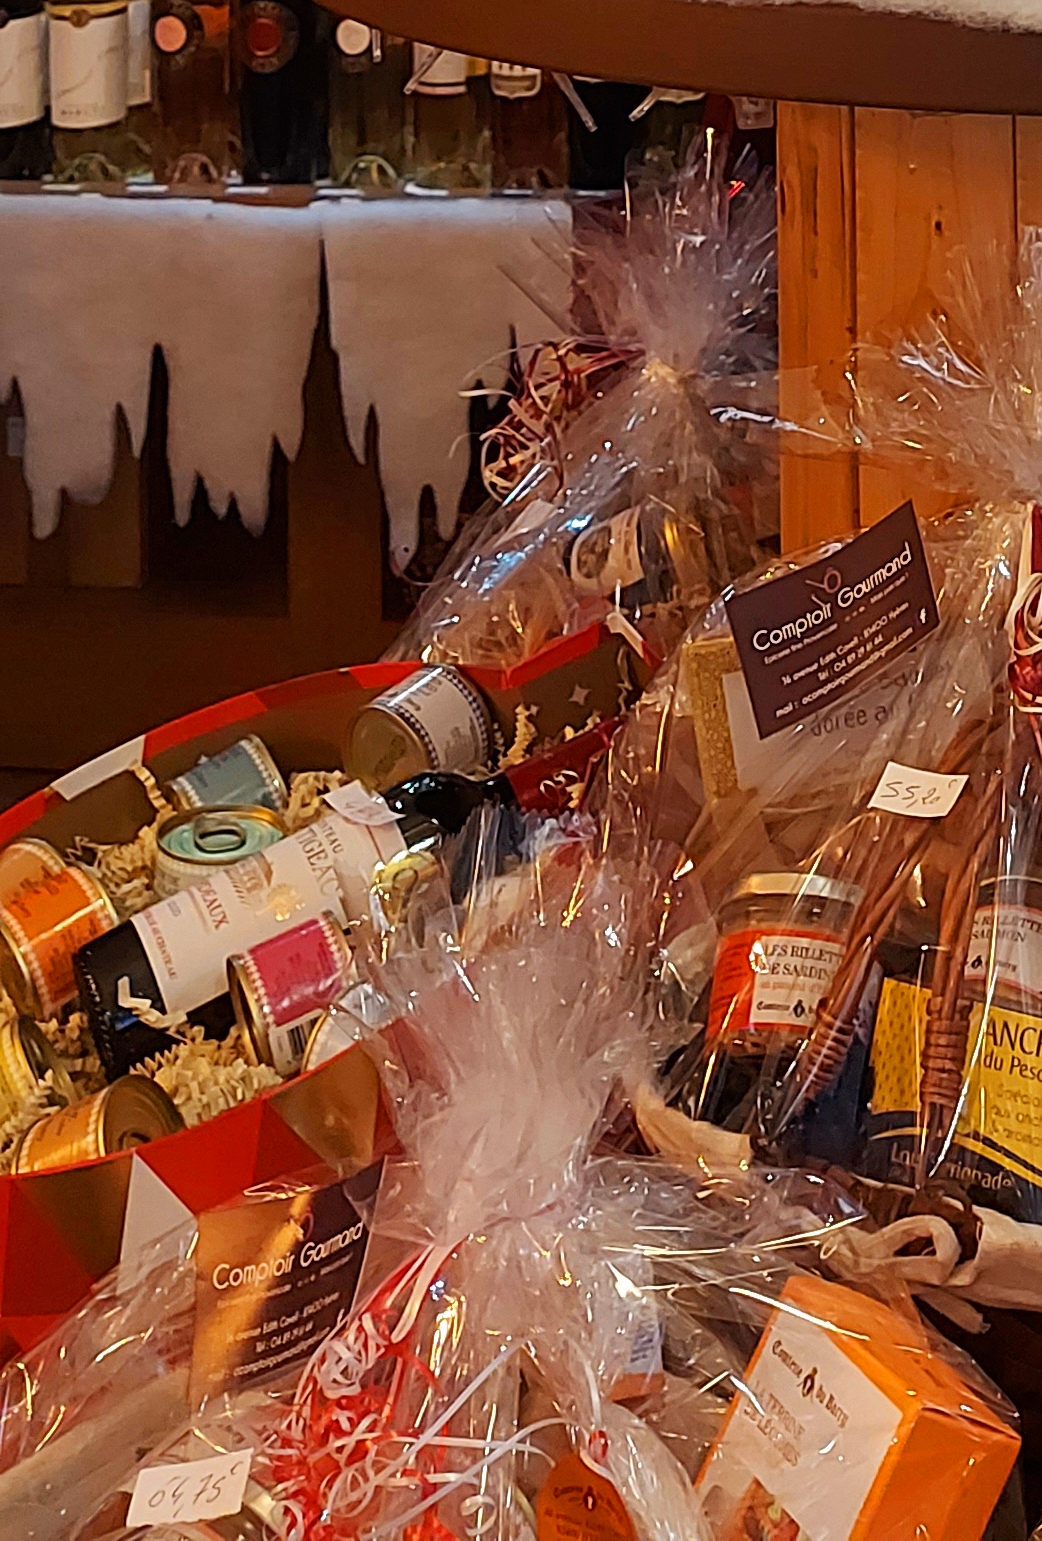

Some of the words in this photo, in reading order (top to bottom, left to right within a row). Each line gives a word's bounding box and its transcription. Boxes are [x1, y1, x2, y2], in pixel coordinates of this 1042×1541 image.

[752, 594, 832, 651] Comptoir
[837, 541, 912, 608] Gourmand
[984, 1050, 1004, 1071] du
[208, 1252, 300, 1290] Comptoir
